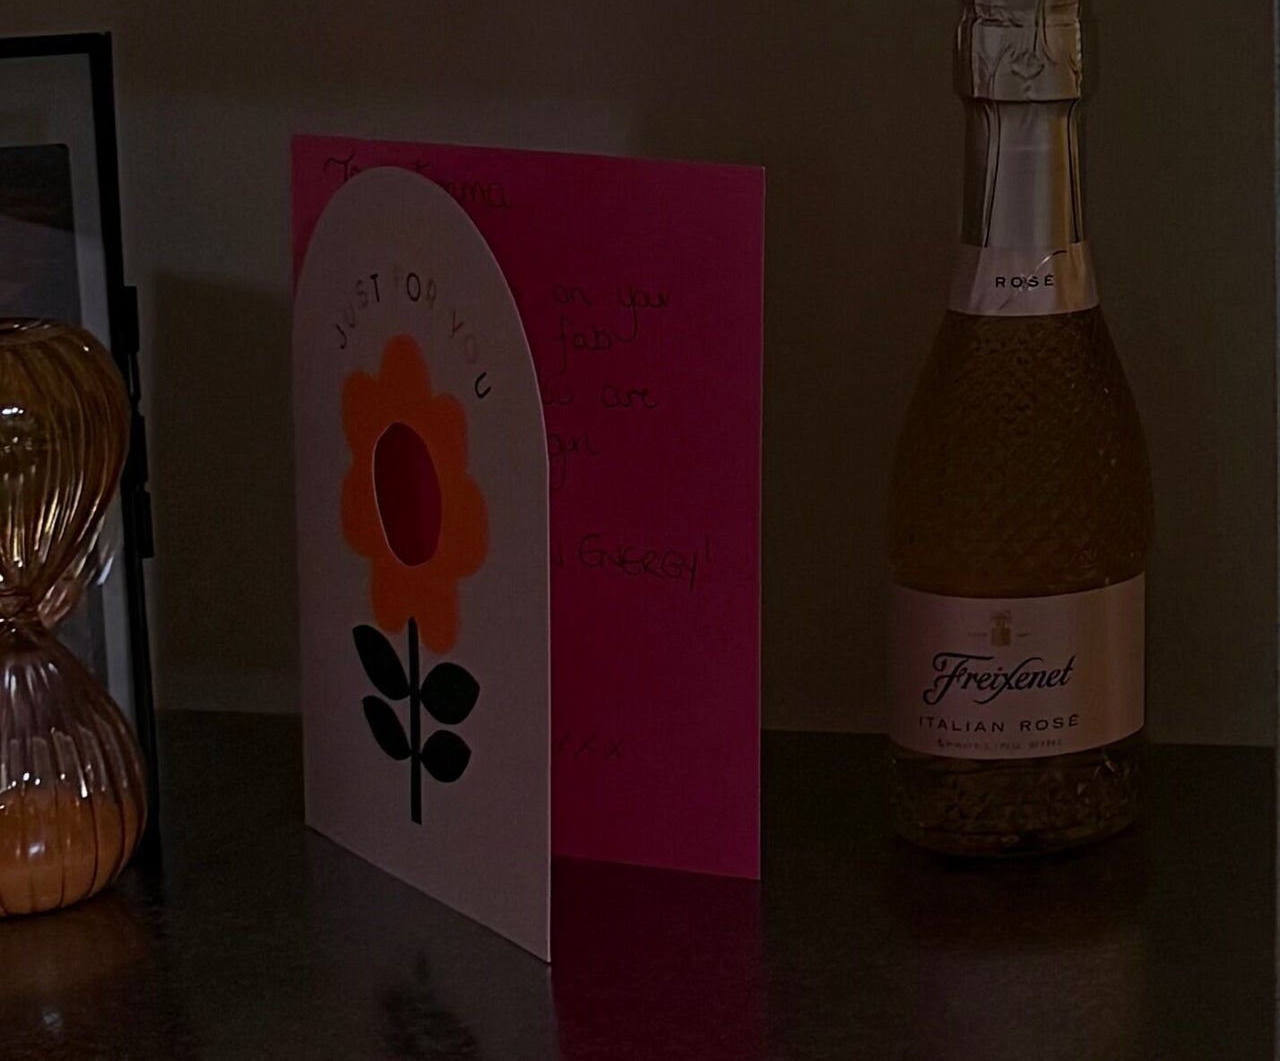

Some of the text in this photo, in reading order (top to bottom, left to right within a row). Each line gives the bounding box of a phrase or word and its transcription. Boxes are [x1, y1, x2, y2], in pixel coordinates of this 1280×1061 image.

[330, 271, 383, 351] JUST
[447, 308, 495, 402] YOU
[921, 650, 1078, 707] Freixenet
[919, 712, 1081, 734] ITALIAN ROSÉ
